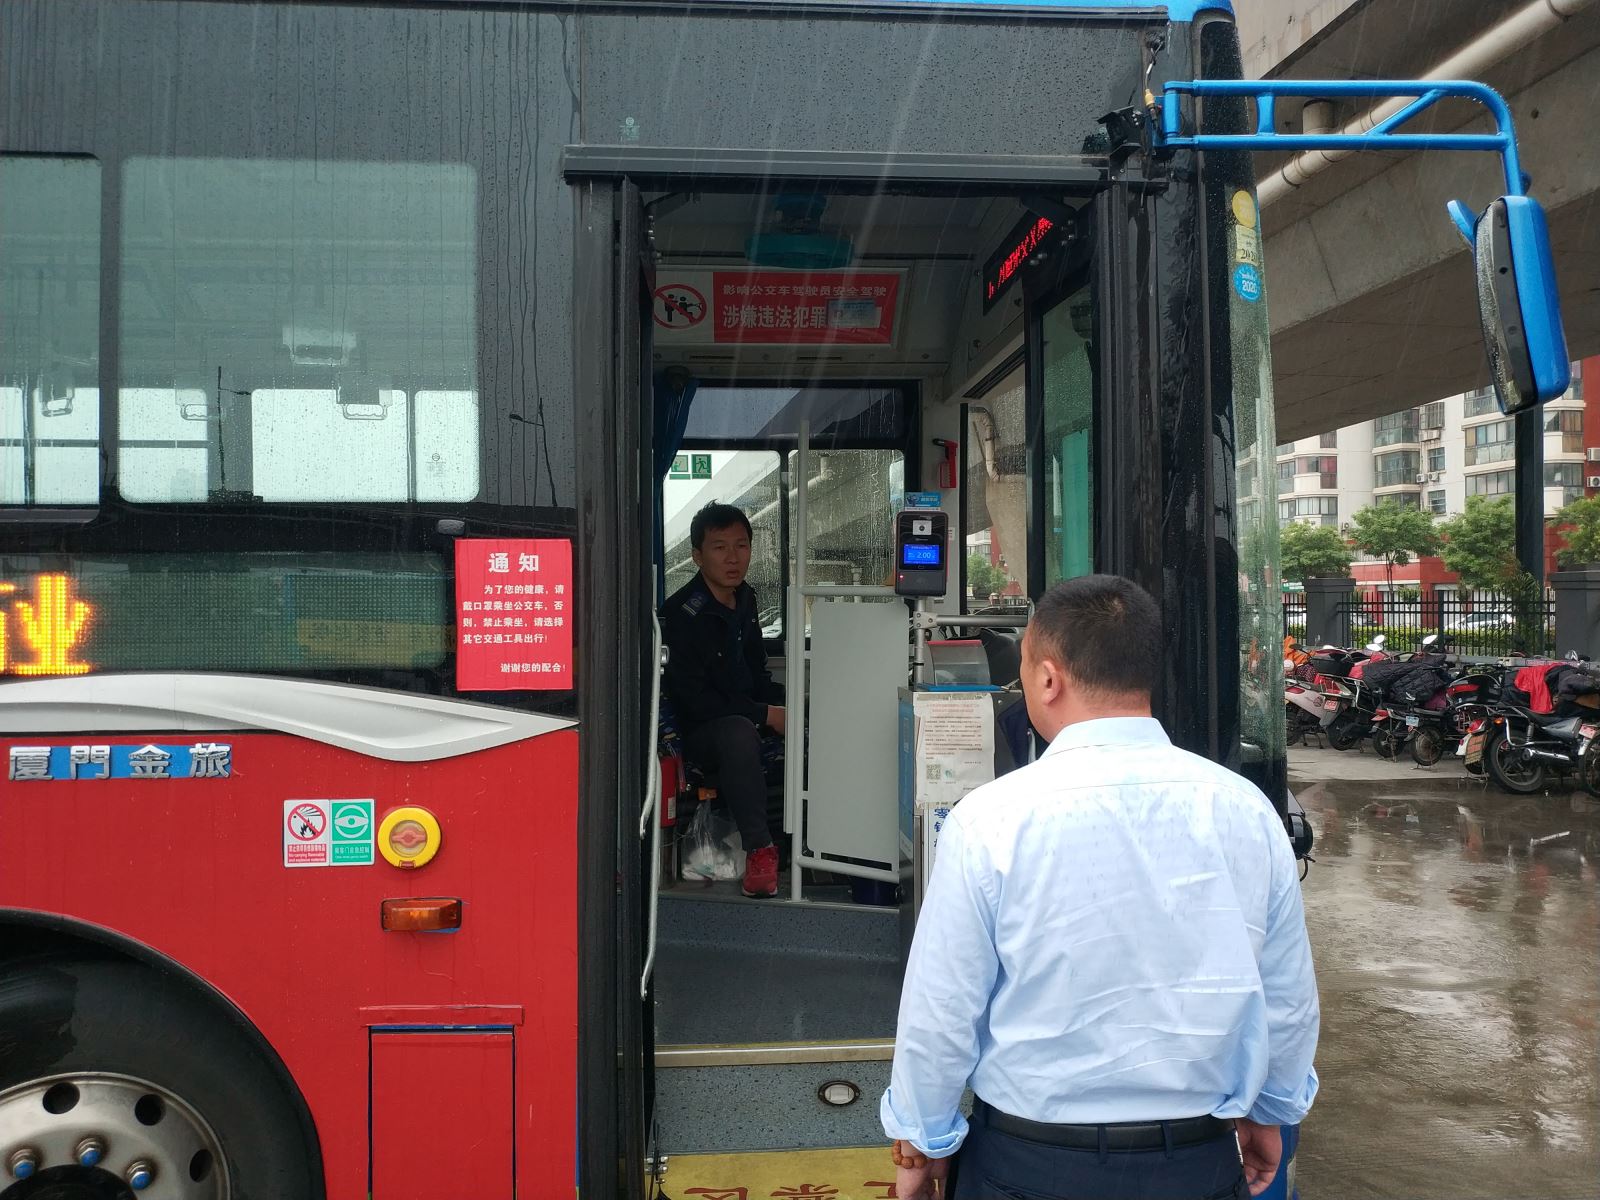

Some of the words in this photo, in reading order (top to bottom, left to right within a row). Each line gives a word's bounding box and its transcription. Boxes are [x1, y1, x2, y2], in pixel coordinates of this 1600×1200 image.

[722, 284, 887, 297] 影响公交车驾驶员安全驾驶
[722, 304, 826, 329] 涉嫌违法犯罪
[488, 552, 540, 573] 通知
[9, 743, 232, 781] 厦門金旅
